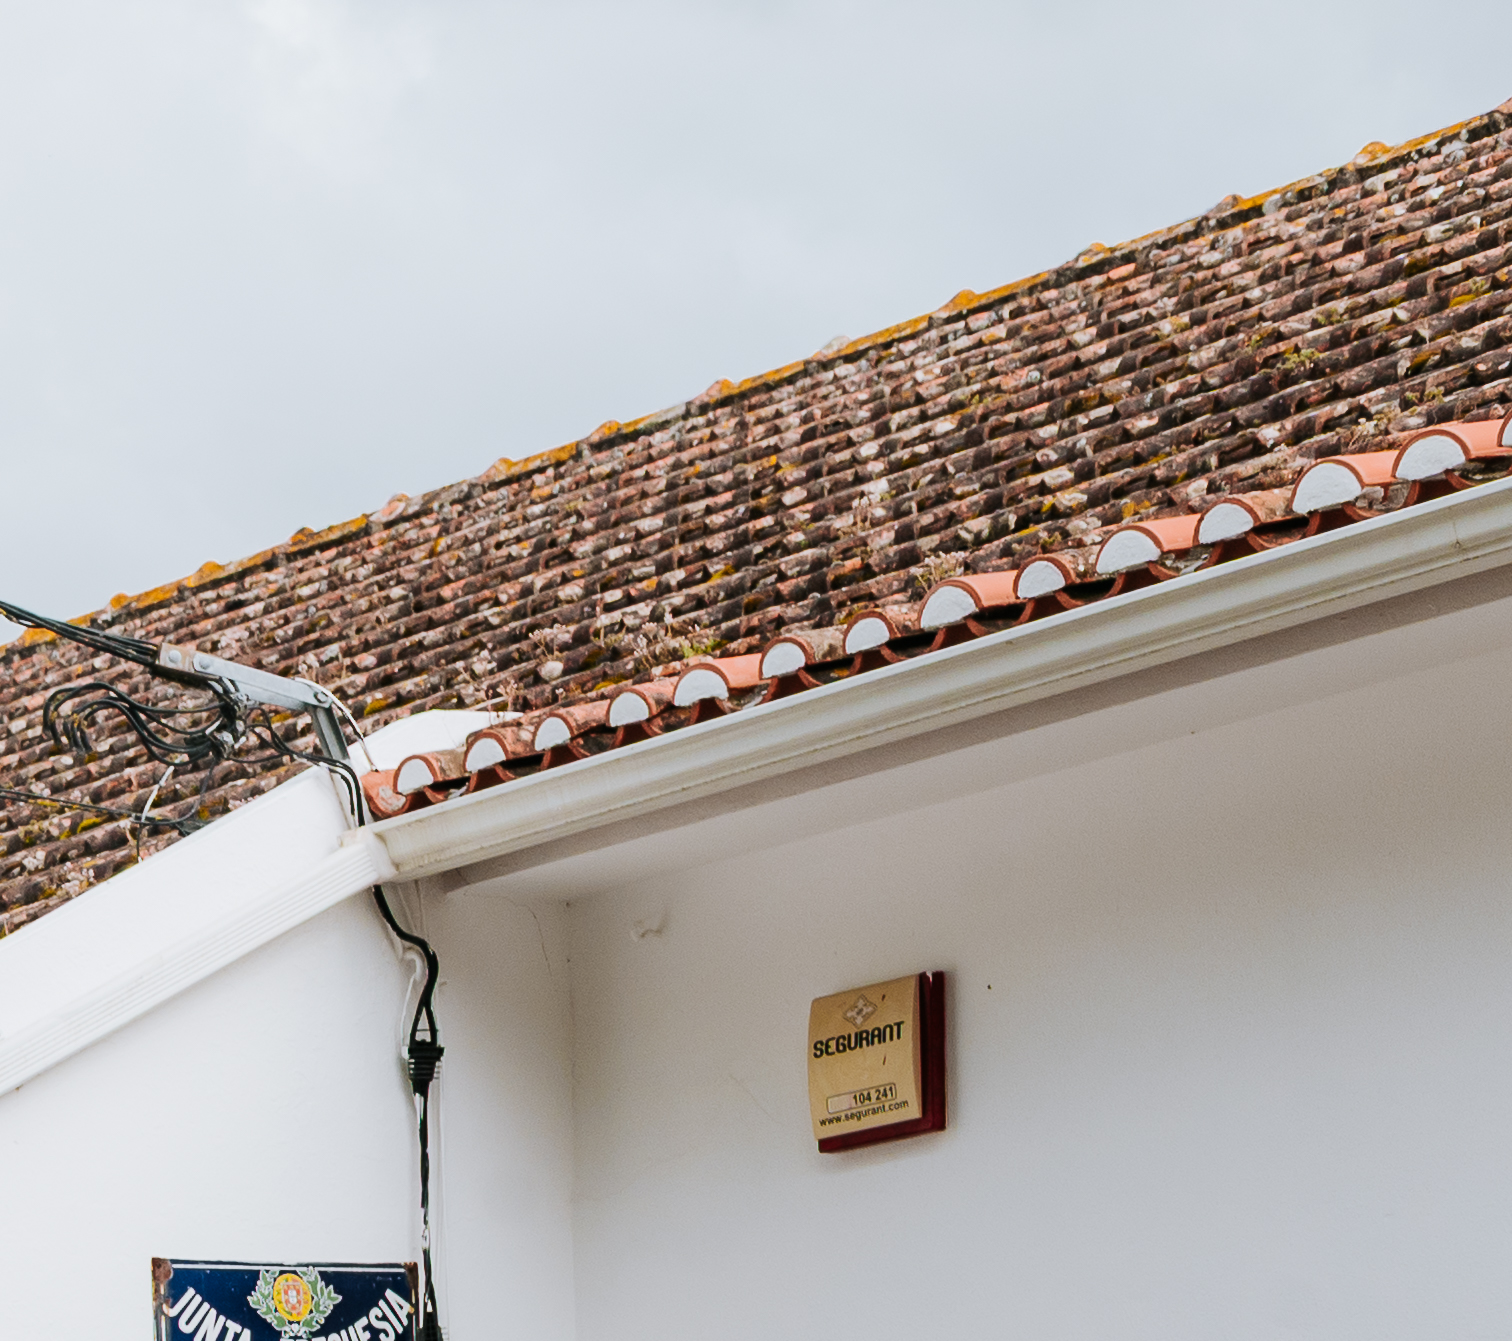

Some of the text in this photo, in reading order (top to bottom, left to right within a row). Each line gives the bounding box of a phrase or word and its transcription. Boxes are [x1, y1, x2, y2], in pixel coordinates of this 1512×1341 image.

[813, 1021, 905, 1058] SEGURANT
[852, 1086, 894, 1106] 104 241
[818, 1099, 910, 1127] www.segurant.com
